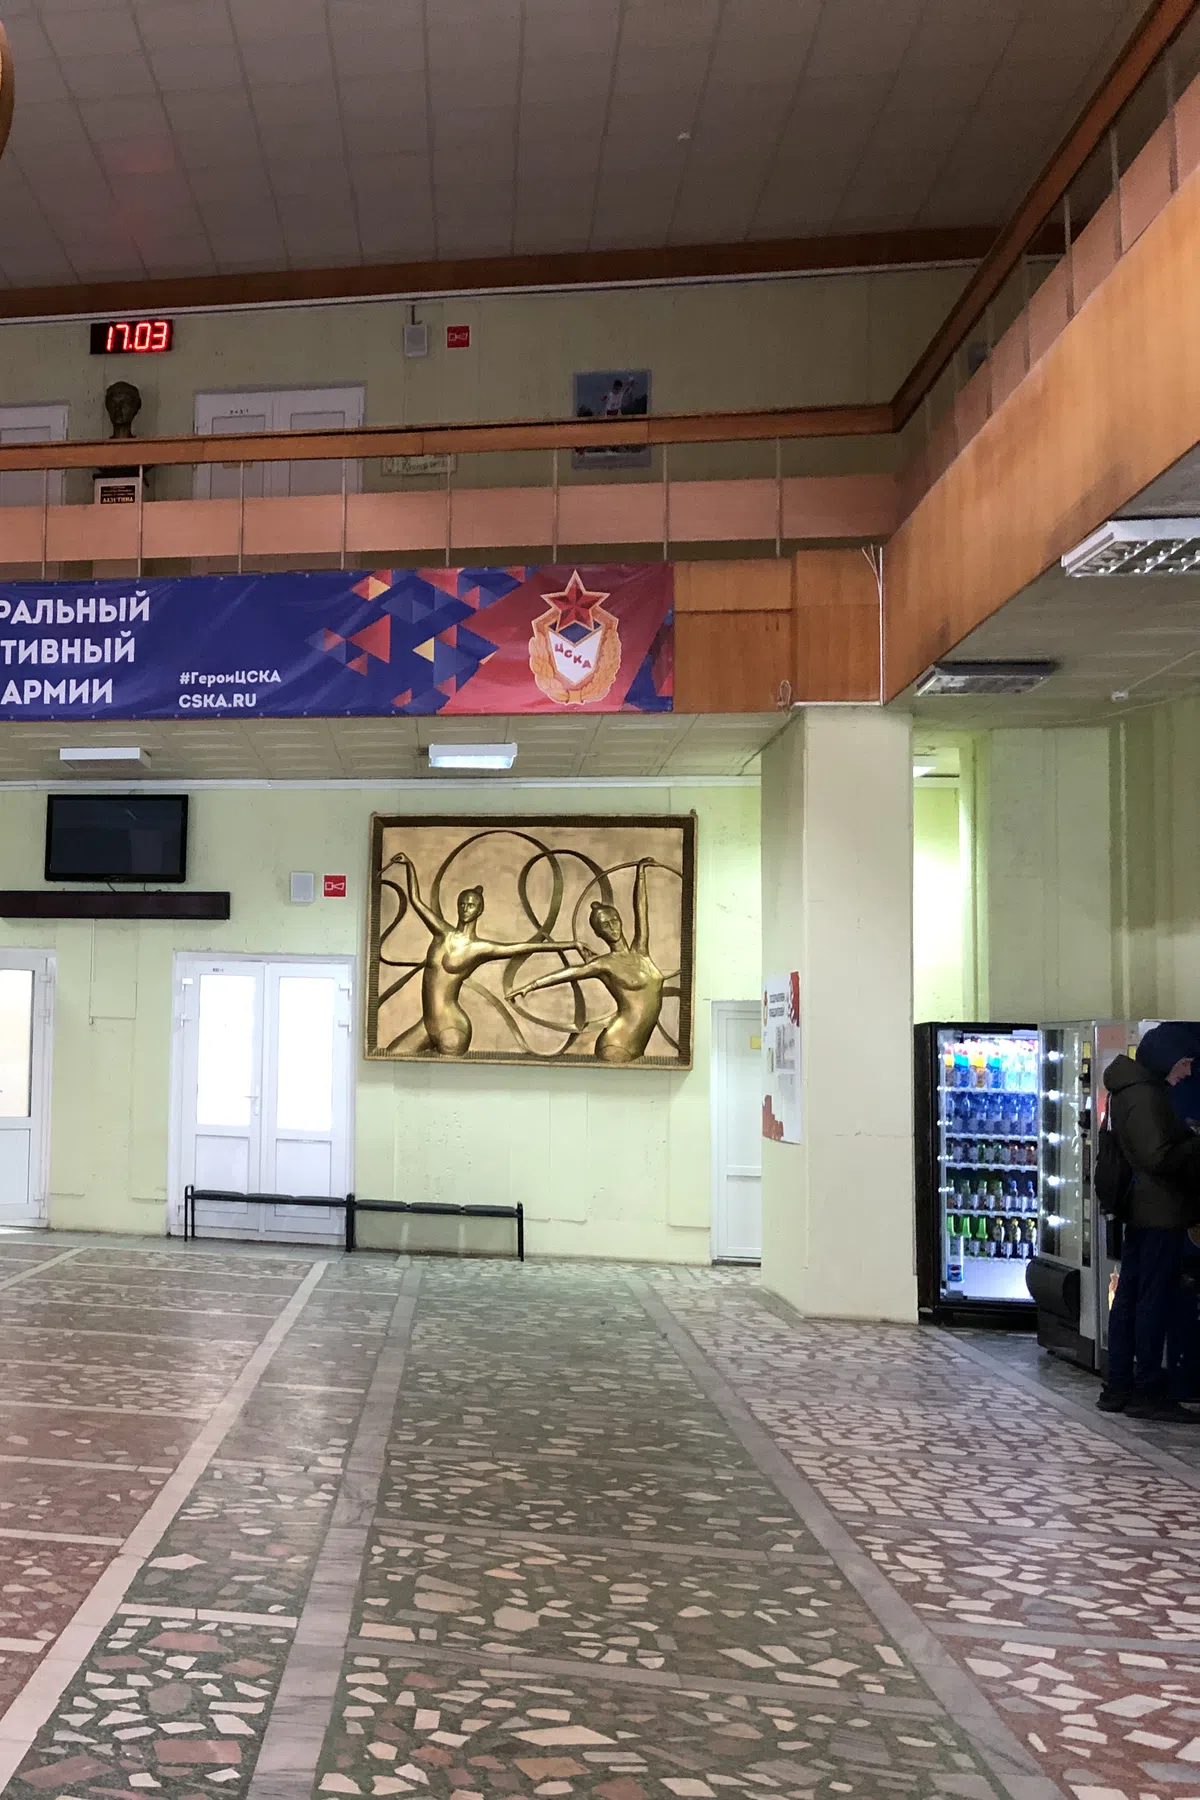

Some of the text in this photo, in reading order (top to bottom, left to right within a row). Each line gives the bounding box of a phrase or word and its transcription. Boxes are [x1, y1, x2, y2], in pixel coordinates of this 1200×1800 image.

[554, 643, 592, 669] ЦСКА
[179, 669, 282, 688] #ГероиЦСКА
[0, 678, 113, 705] АРМИИ
[178, 693, 257, 708] CSKA.RU
